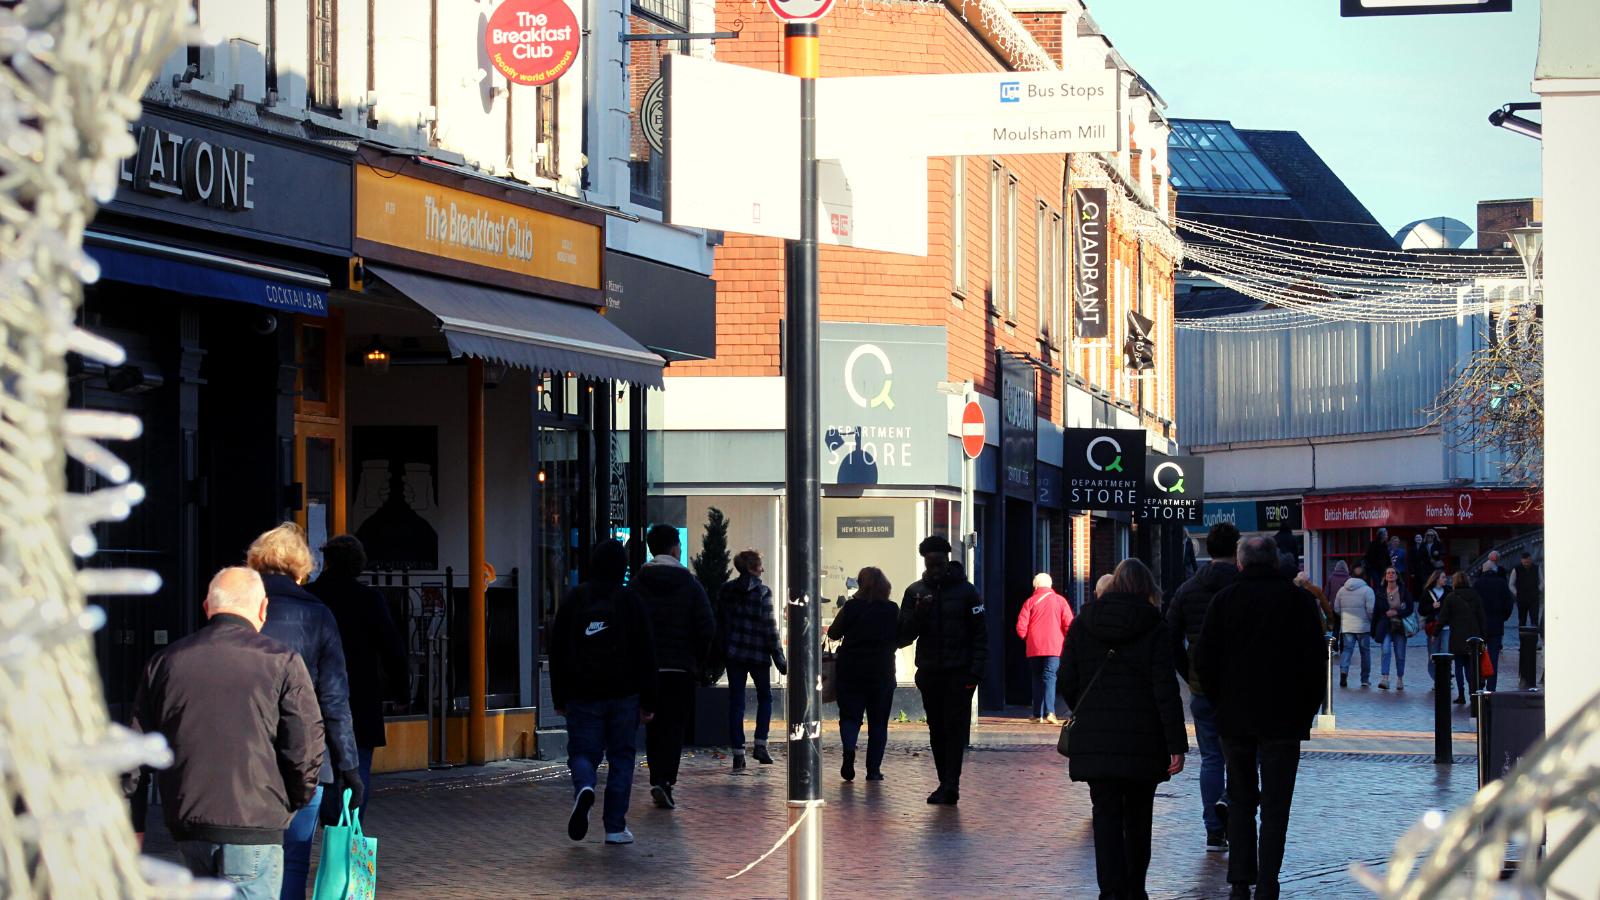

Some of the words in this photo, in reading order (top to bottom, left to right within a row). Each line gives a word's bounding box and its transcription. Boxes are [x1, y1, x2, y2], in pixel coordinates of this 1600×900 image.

[516, 11, 548, 27] The
[492, 25, 572, 44] Breakfast
[512, 43, 553, 59] Club
[494, 53, 519, 79] locally
[519, 72, 546, 82] world
[545, 50, 572, 77] famous
[1028, 84, 1055, 97] Bus
[1060, 83, 1105, 101] Stops
[993, 126, 1072, 141] Moulsham
[1078, 124, 1105, 139] Mill
[425, 195, 448, 243] The
[450, 202, 505, 256] Breakfast
[506, 216, 534, 262] Club
[1082, 202, 1099, 325] QUADRANT
[608, 280, 624, 293] Pizzeria
[266, 285, 306, 308] COCKTAIL
[307, 292, 324, 310] BAR
[828, 425, 912, 438] DEPARTMENT
[828, 441, 912, 467] STORE
[1071, 479, 1137, 488] DEPARTMENT
[1071, 488, 1137, 504] STORE
[1203, 508, 1236, 527] oundland
[1324, 508, 1342, 521] British
[1342, 507, 1358, 520] Heart
[1358, 506, 1390, 520] Foundation
[1426, 505, 1443, 517] Home
[589, 621, 605, 630] NIKE
